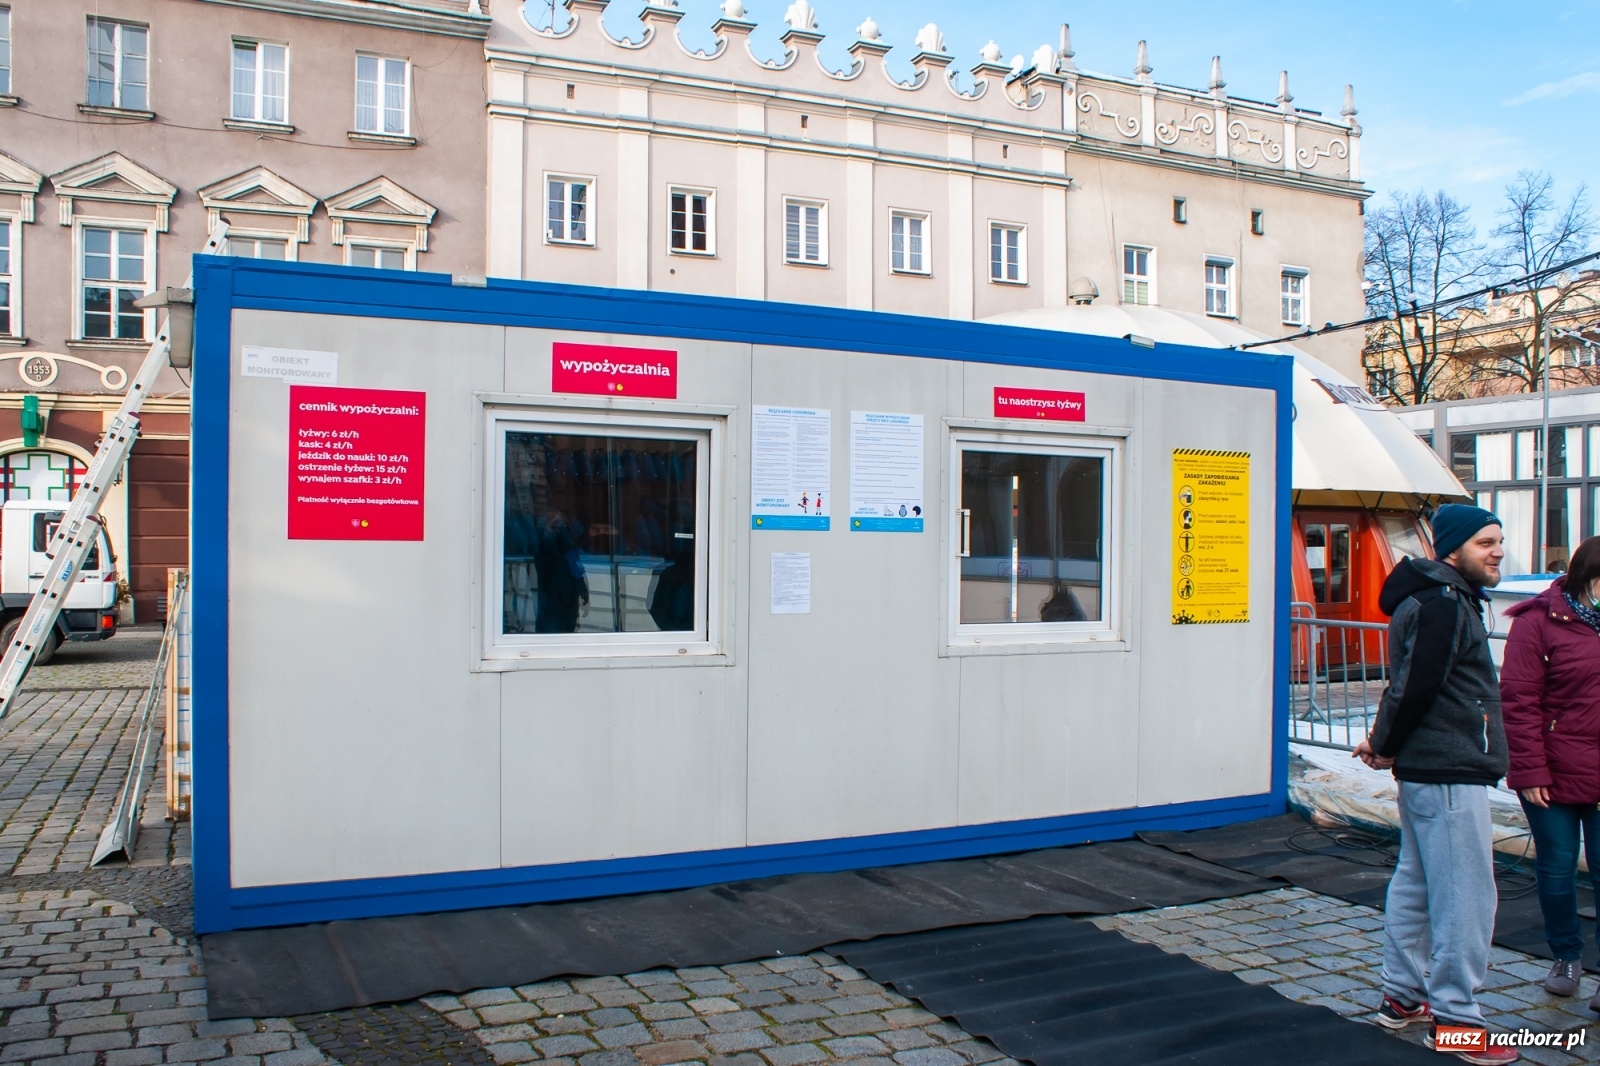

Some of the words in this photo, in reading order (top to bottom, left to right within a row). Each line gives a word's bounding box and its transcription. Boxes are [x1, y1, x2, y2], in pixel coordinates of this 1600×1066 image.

[271, 355, 310, 365] OBIEKT
[28, 365, 50, 374] 1953
[247, 366, 331, 379] MONITOROWANY
[560, 359, 670, 376] wypożyczalnia
[998, 396, 1008, 404] tu
[1009, 398, 1055, 408] naostrzysz
[1056, 400, 1082, 410] łyżwy
[298, 402, 338, 412] cennik
[340, 403, 419, 416] wypożyczalni:
[298, 428, 330, 438] łyżwy:
[339, 430, 359, 438] zł/h
[298, 440, 324, 448] kask:
[333, 441, 353, 450] zł/h
[298, 451, 332, 460] jeździk
[333, 452, 346, 461] do
[347, 453, 376, 462] nauki:
[377, 454, 387, 462] 10
[389, 454, 409, 463] zł/h
[298, 463, 342, 472] ostrzenie
[344, 464, 374, 473] łyżew:
[387, 465, 407, 474] zł/h
[298, 475, 341, 484] wynajem
[343, 475, 373, 484] szafki:
[382, 476, 402, 485] zł/h
